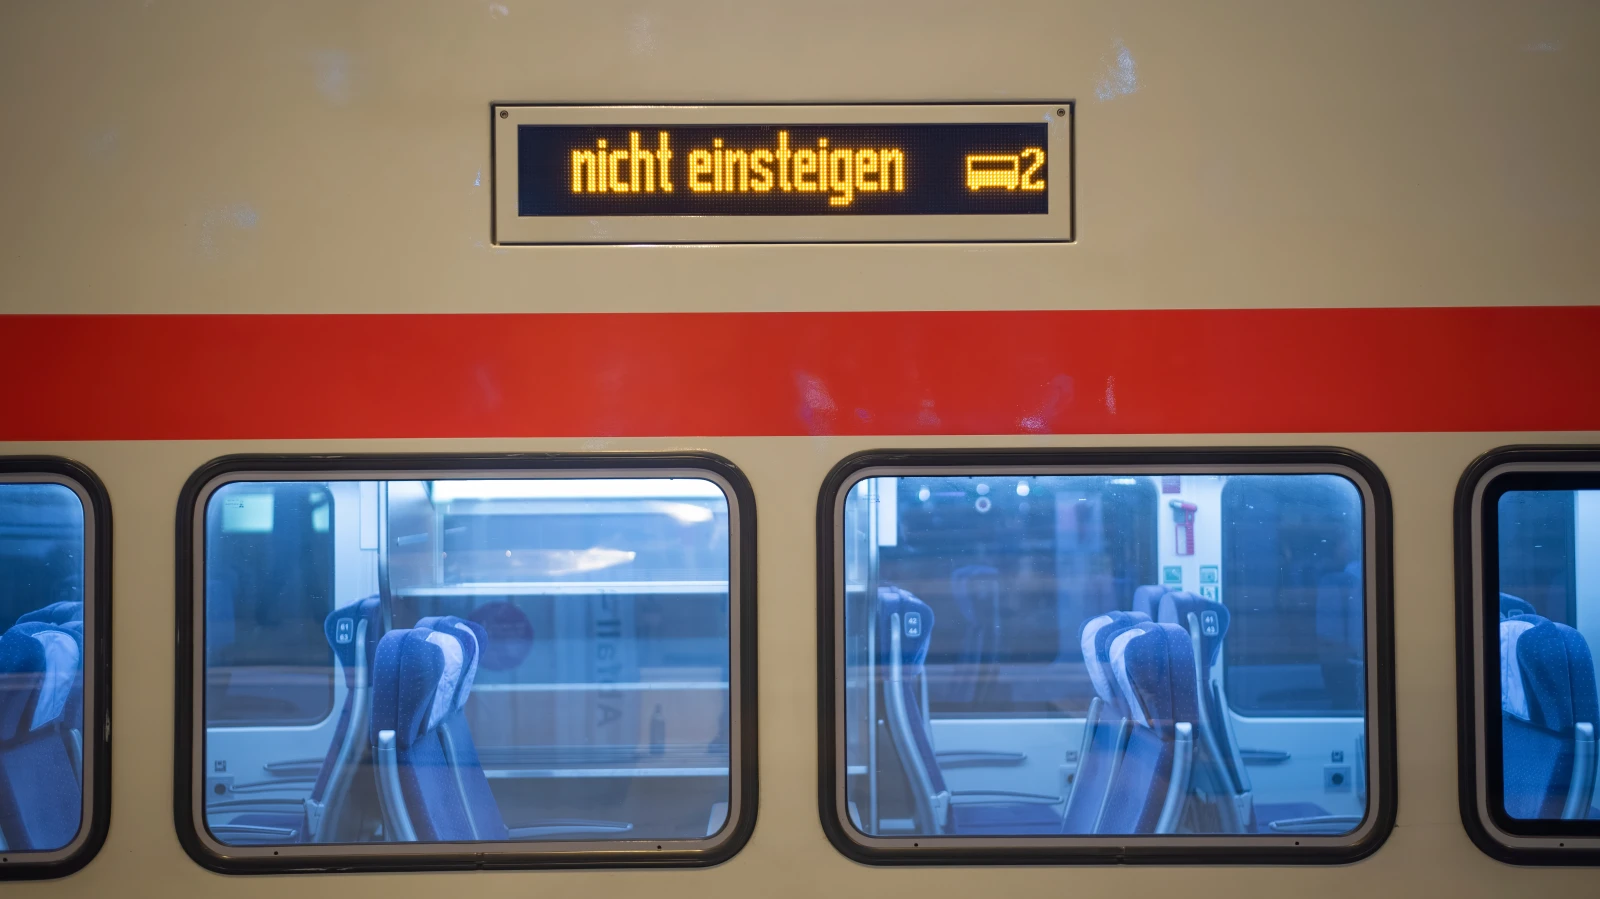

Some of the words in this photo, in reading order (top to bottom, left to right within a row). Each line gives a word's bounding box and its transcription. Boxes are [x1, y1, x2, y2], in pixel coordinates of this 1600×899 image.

[571, 131, 673, 194] nicht
[688, 131, 905, 207] einsteigen
[1021, 148, 1046, 191] 2
